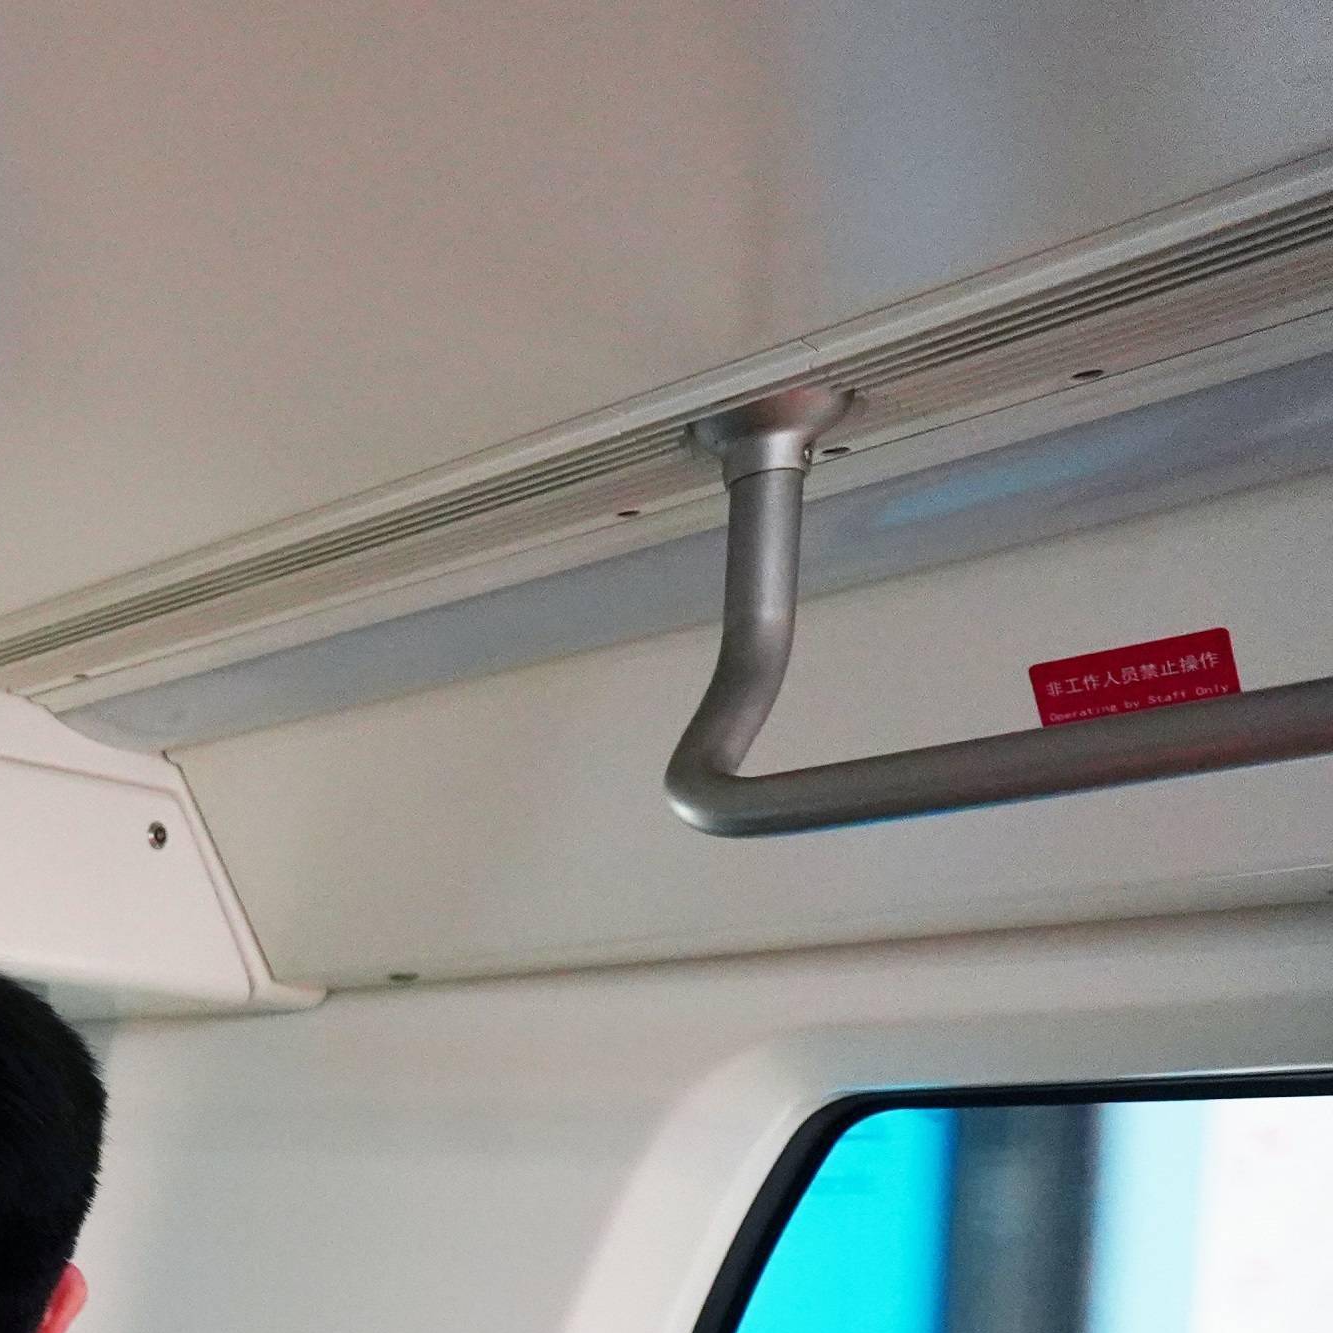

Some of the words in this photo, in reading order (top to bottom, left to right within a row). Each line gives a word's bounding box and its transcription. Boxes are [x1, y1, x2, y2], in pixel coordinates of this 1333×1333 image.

[1046, 651, 1221, 697] 非工作人员禁止操作
[1124, 697, 1140, 711] by
[1147, 690, 1187, 705] Staff
[1196, 682, 1230, 698] Only
